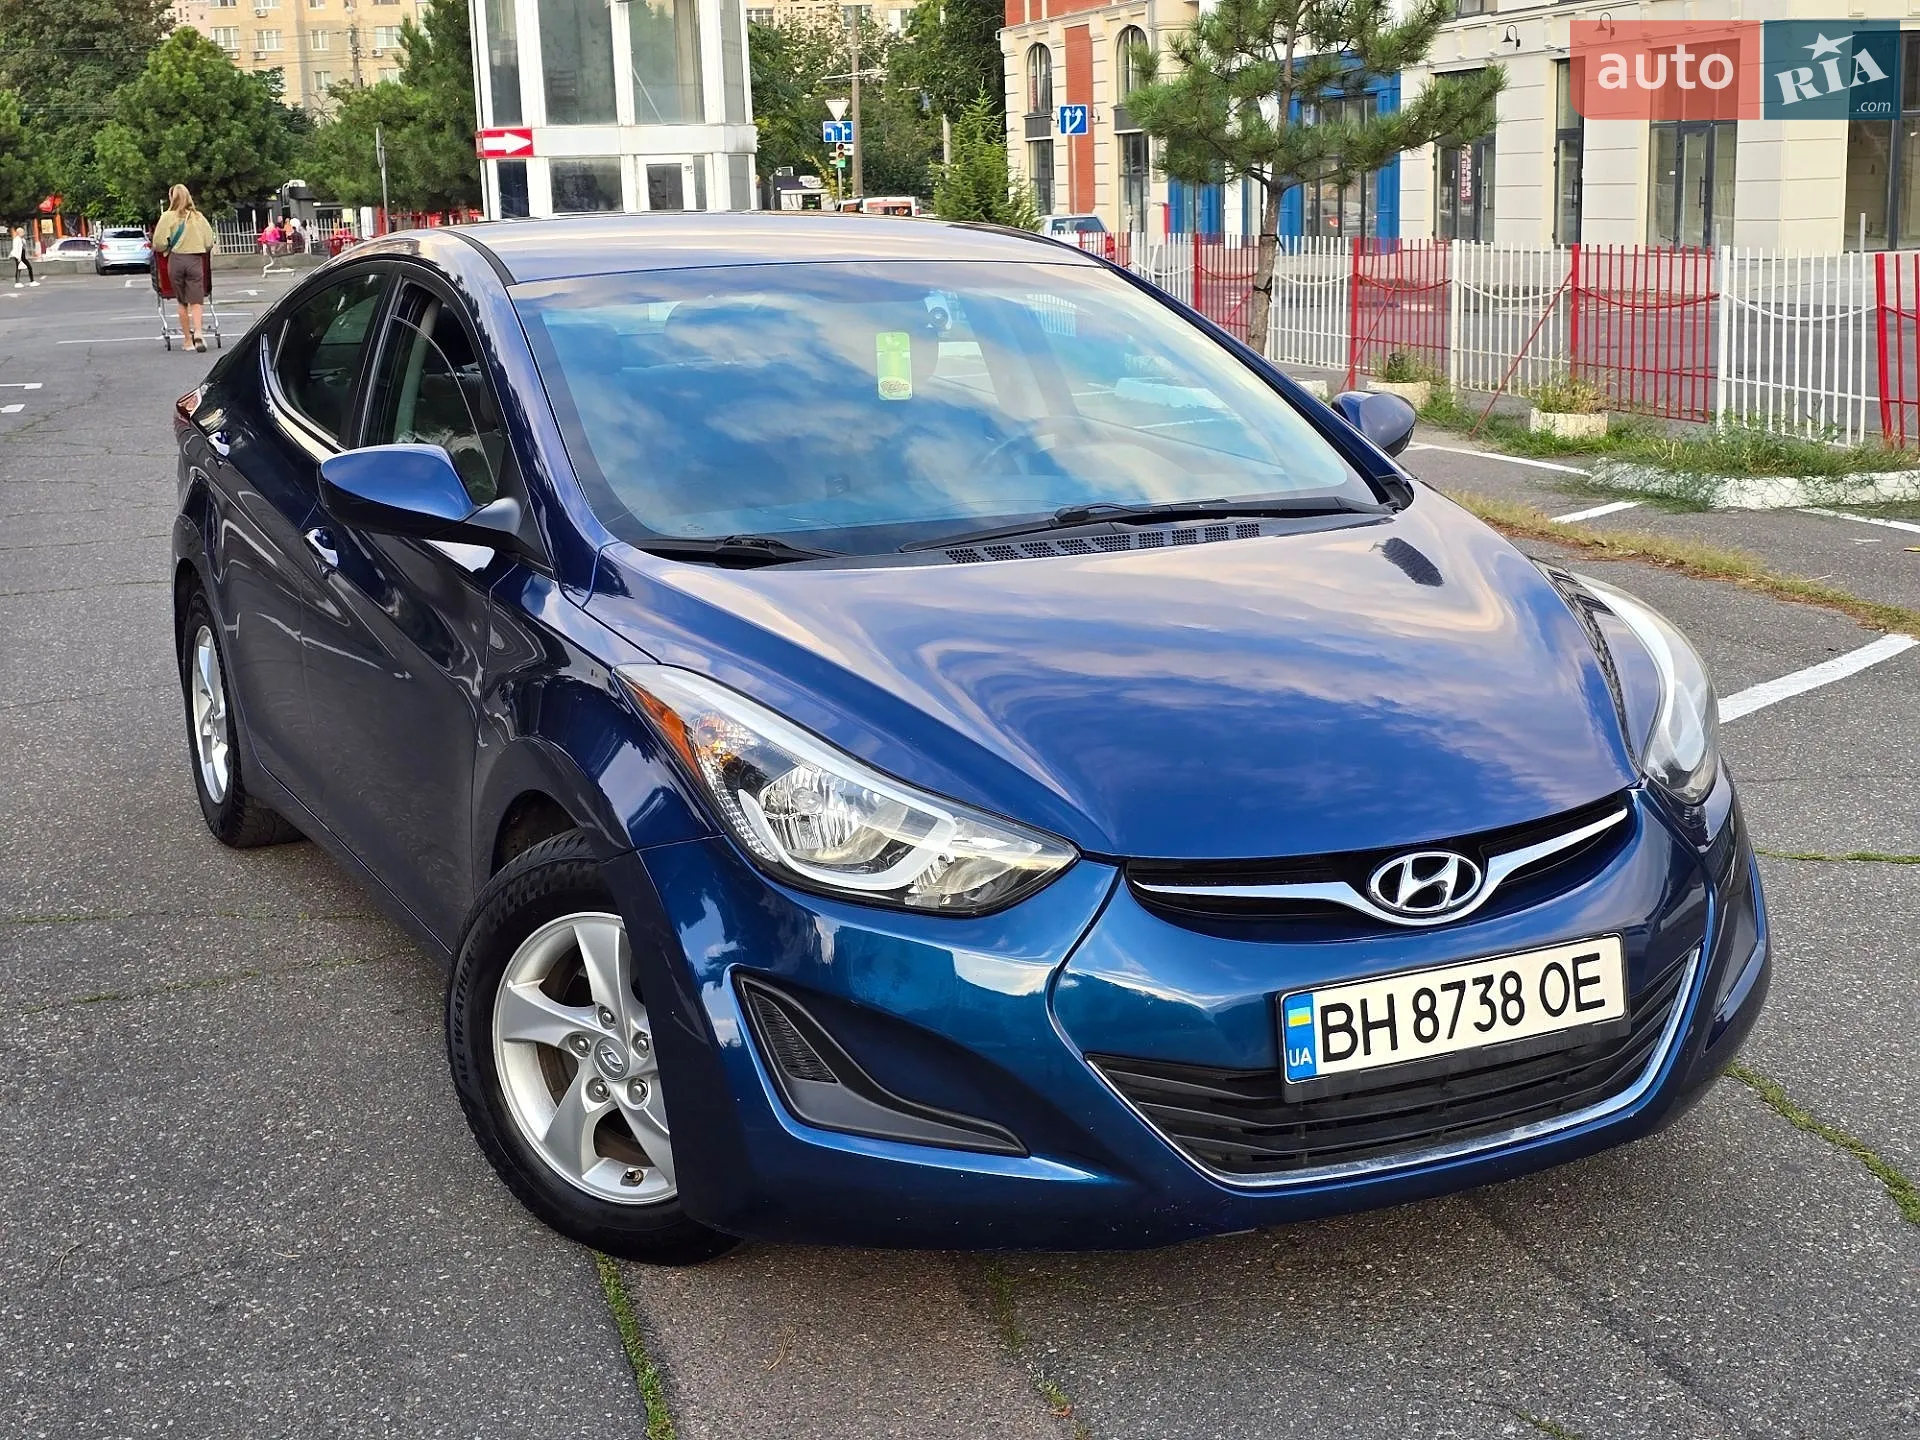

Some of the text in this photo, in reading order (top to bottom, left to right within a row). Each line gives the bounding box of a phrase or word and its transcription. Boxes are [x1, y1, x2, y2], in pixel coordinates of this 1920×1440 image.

[1320, 952, 1606, 1063] BH 8738 OE
[1288, 1047, 1313, 1068] UA
